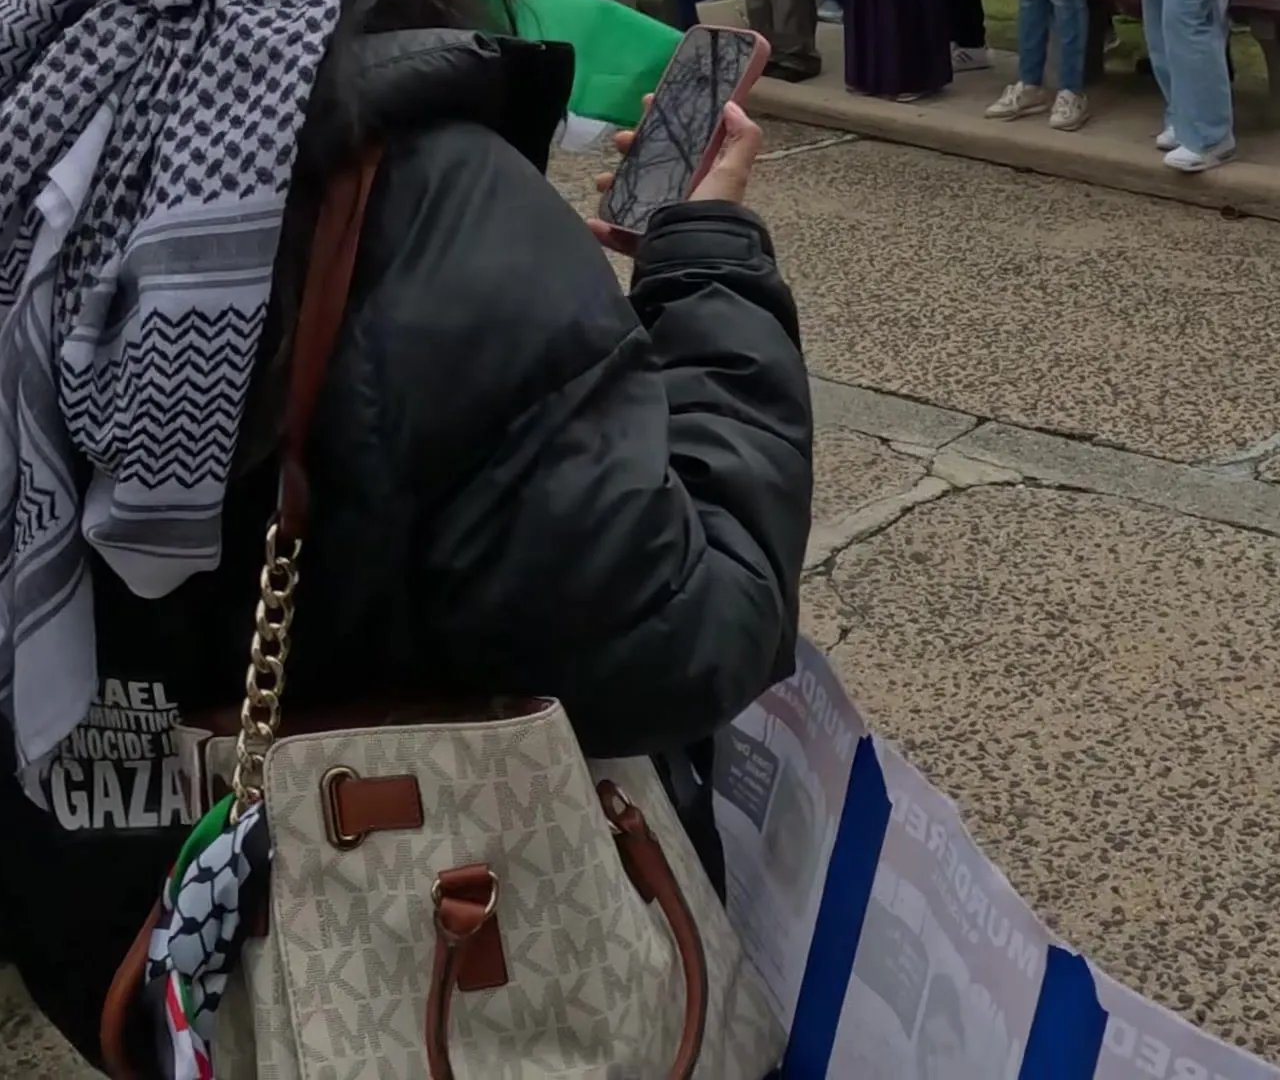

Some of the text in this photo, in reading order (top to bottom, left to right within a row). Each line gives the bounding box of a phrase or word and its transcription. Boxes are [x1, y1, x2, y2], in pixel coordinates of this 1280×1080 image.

[101, 677, 180, 710] AEL
[85, 706, 184, 734] MMITTING
[59, 726, 157, 761] ENOCIDE
[50, 759, 192, 831] GAZA
